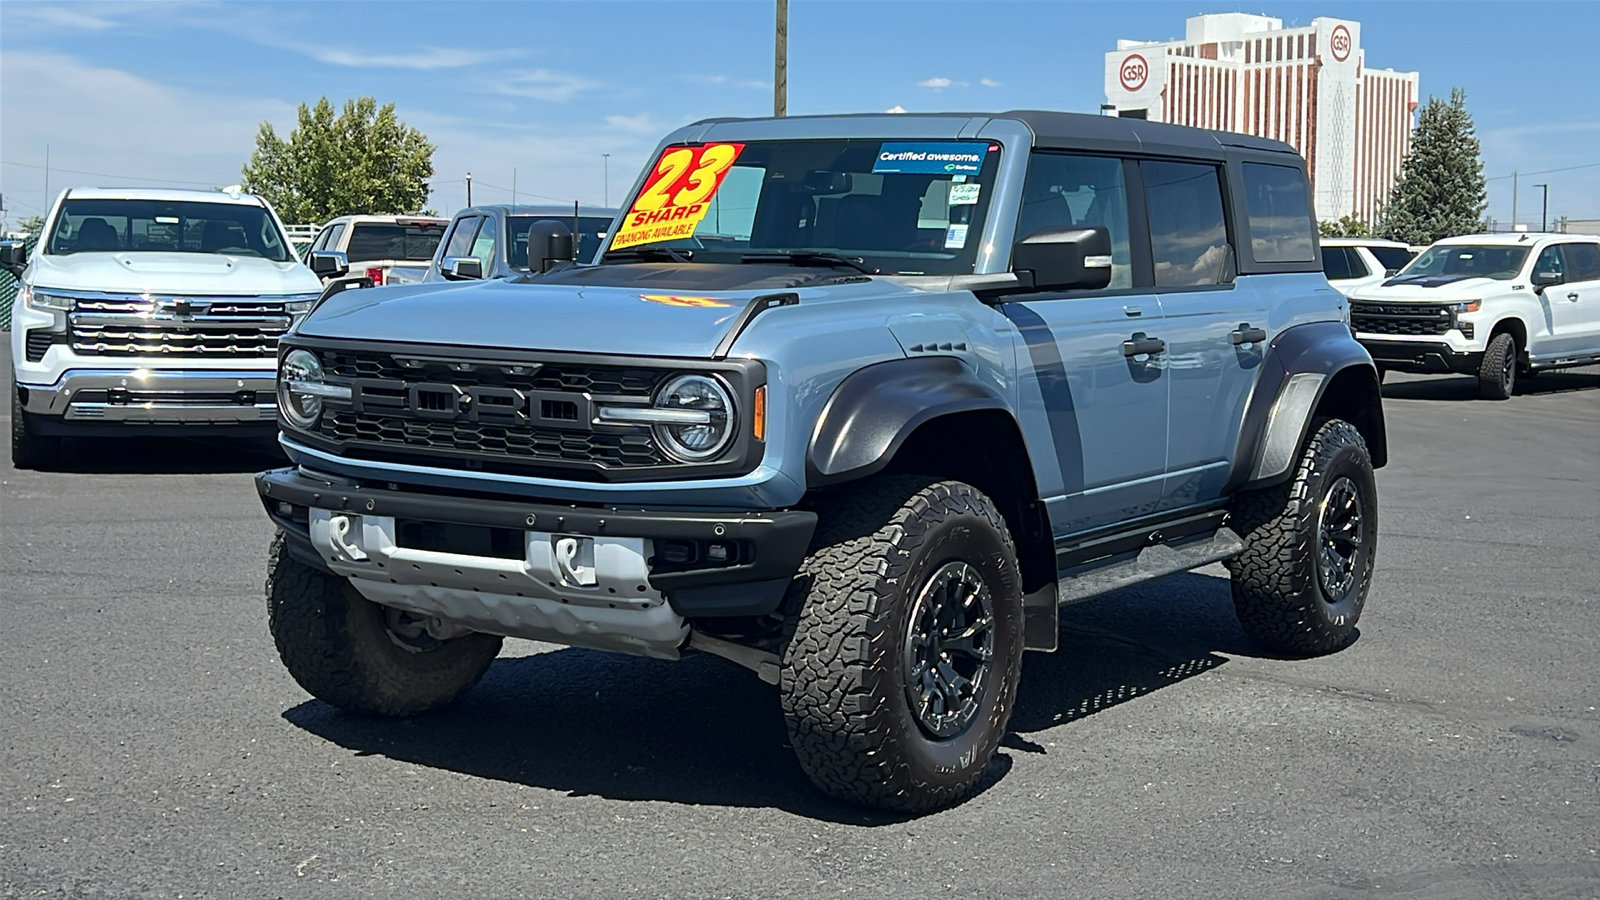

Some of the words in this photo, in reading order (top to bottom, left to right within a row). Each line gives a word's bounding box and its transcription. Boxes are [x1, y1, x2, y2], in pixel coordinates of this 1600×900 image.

[1333, 35, 1349, 53] GSR
[1122, 65, 1145, 81] GSR
[880, 151, 926, 161] Certified
[927, 153, 980, 162] awesome.
[634, 144, 735, 211] 23
[631, 204, 702, 227] SHARP
[614, 229, 653, 246] FINANCING
[652, 223, 694, 239] AVAILABLE
[351, 378, 593, 430] FORD
